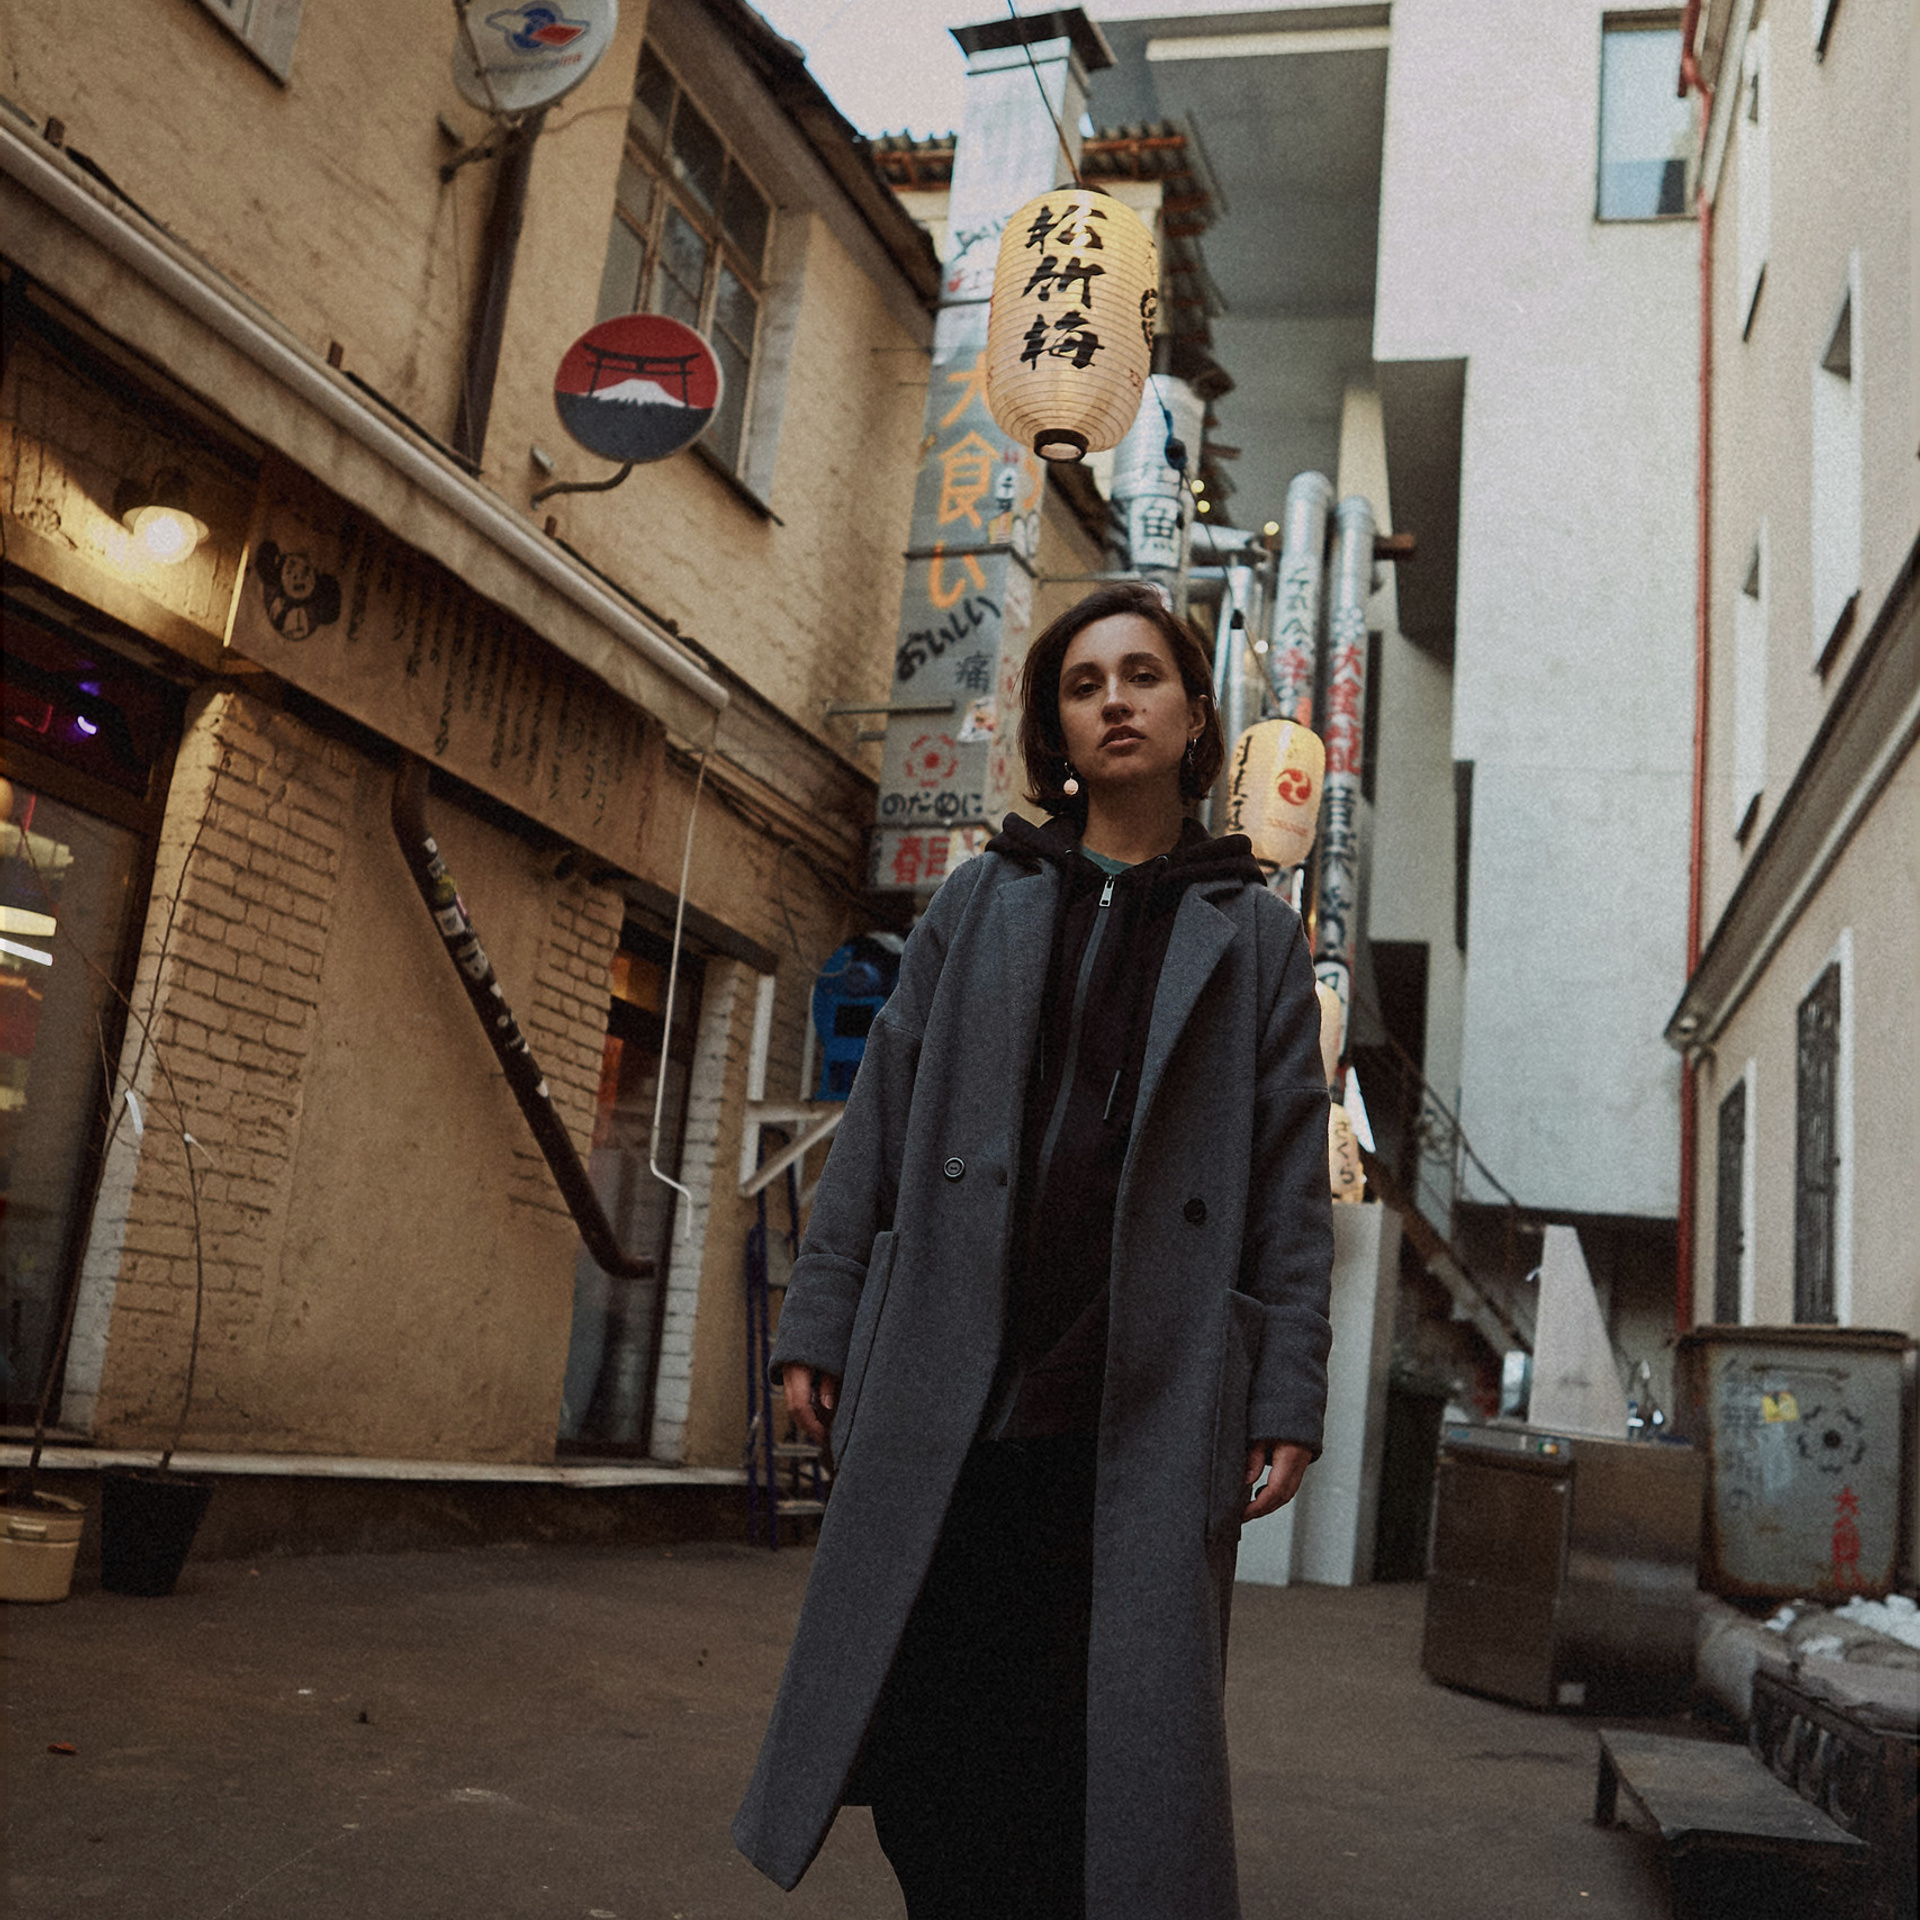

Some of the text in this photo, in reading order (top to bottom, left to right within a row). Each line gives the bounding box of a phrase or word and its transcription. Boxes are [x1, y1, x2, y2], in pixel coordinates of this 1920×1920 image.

[1019, 204, 1108, 371] 松竹梅
[1139, 498, 1176, 552] 魚
[896, 595, 1002, 681] おいしい
